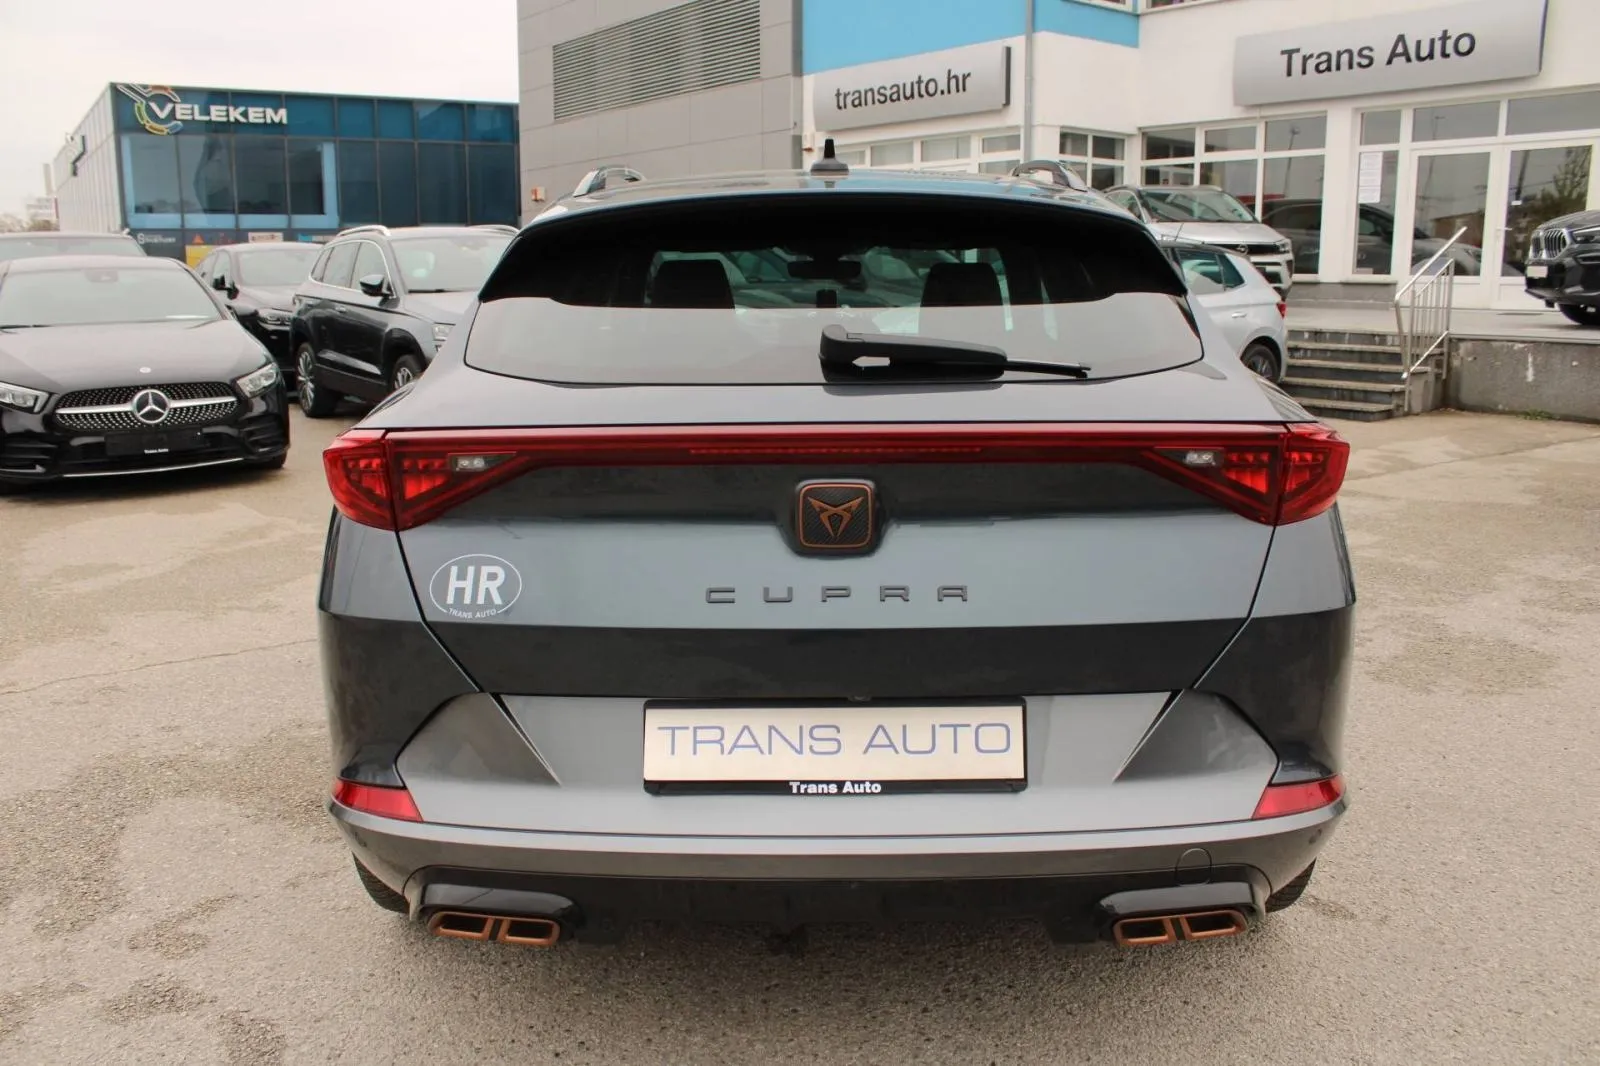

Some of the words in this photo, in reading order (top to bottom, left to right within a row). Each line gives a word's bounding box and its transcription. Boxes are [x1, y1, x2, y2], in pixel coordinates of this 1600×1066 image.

[1280, 45, 1375, 77] Trans
[1386, 29, 1477, 66] Auto
[834, 69, 972, 110] transauto.hr
[149, 101, 288, 124] VELEKEM
[446, 565, 506, 605] HR
[705, 585, 968, 604] CUPRA
[448, 607, 473, 619] TRANS
[474, 608, 497, 619] AUTO
[657, 724, 842, 756] TRANS
[862, 722, 1012, 754] AUTO
[788, 781, 838, 794] Trans
[842, 780, 882, 794] Auto
